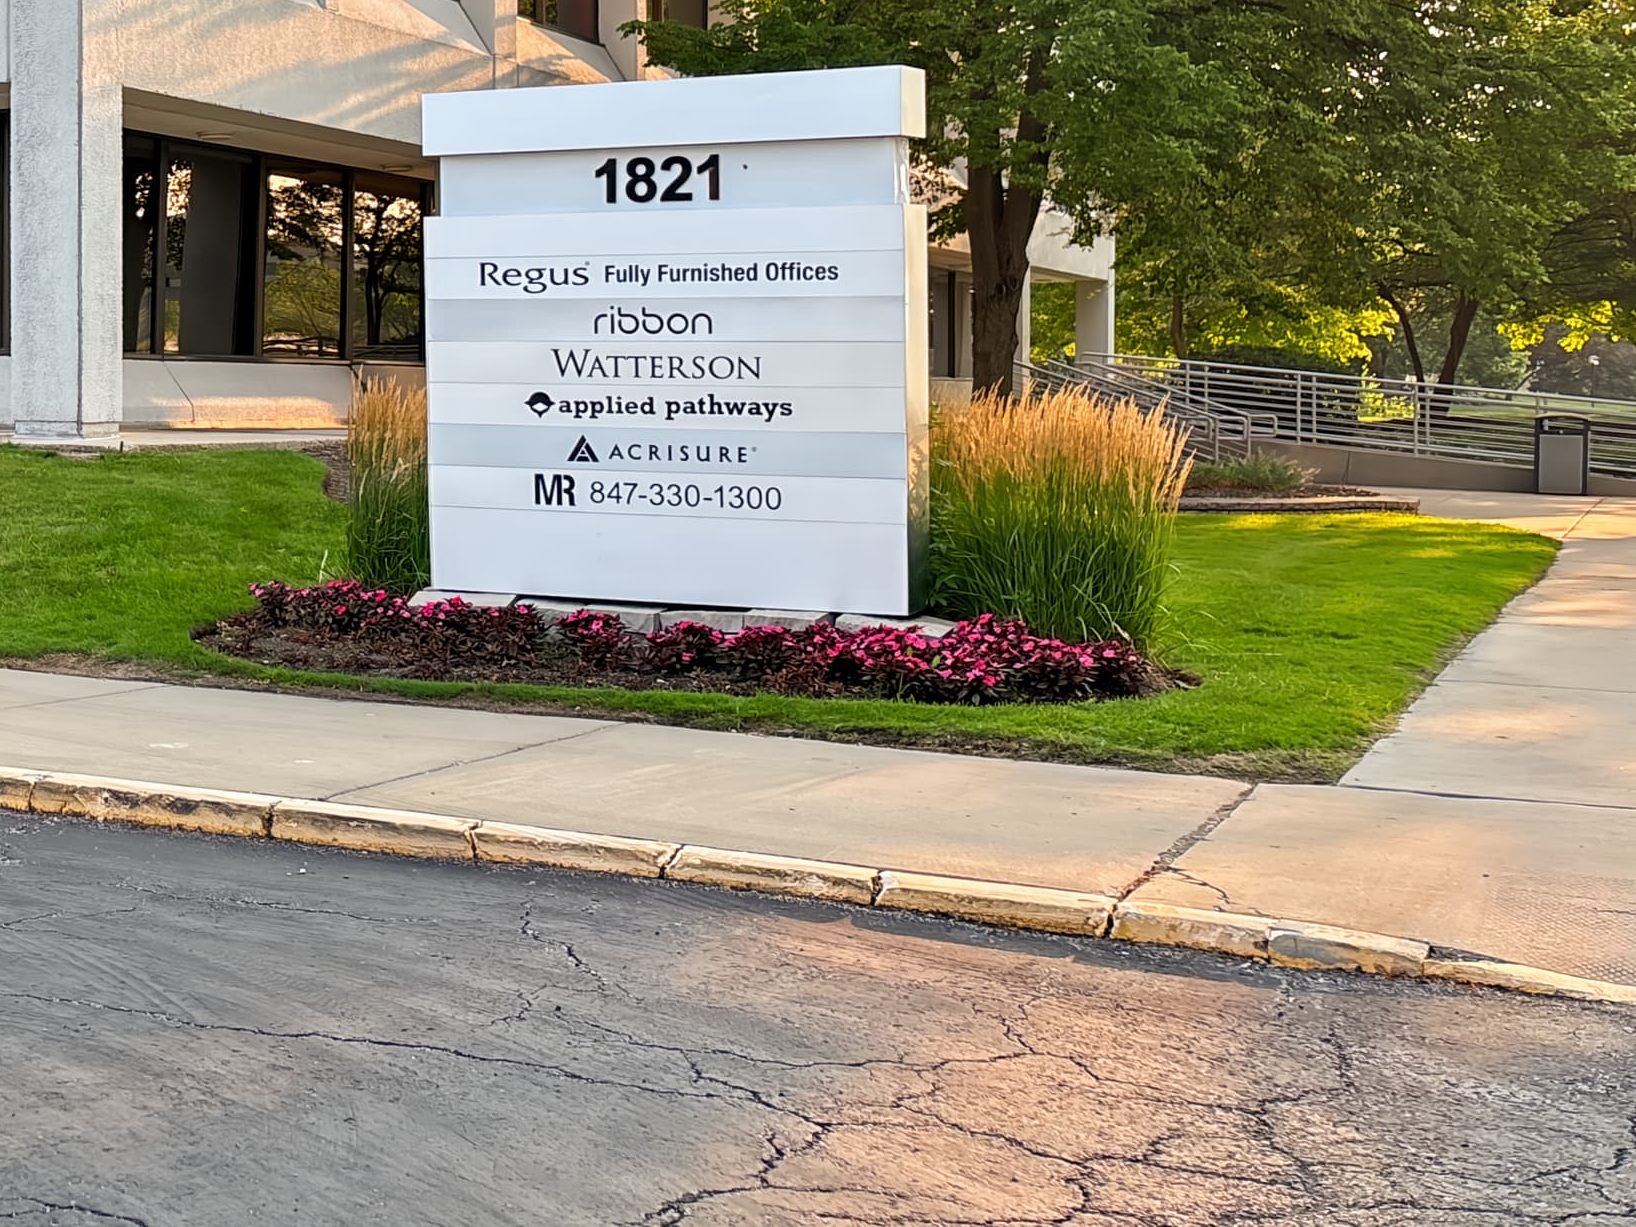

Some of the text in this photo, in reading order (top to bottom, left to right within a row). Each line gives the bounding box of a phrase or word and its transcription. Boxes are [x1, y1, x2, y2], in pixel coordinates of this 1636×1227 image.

[594, 153, 721, 205] 1821
[479, 261, 839, 295] Regus Fully Furnished Offices
[593, 304, 713, 335] ribbon
[549, 348, 762, 380] WATTERSON
[558, 392, 793, 423] applied pathways
[608, 443, 748, 464] ACRISURE
[534, 473, 782, 511] MR 847-330-1300
